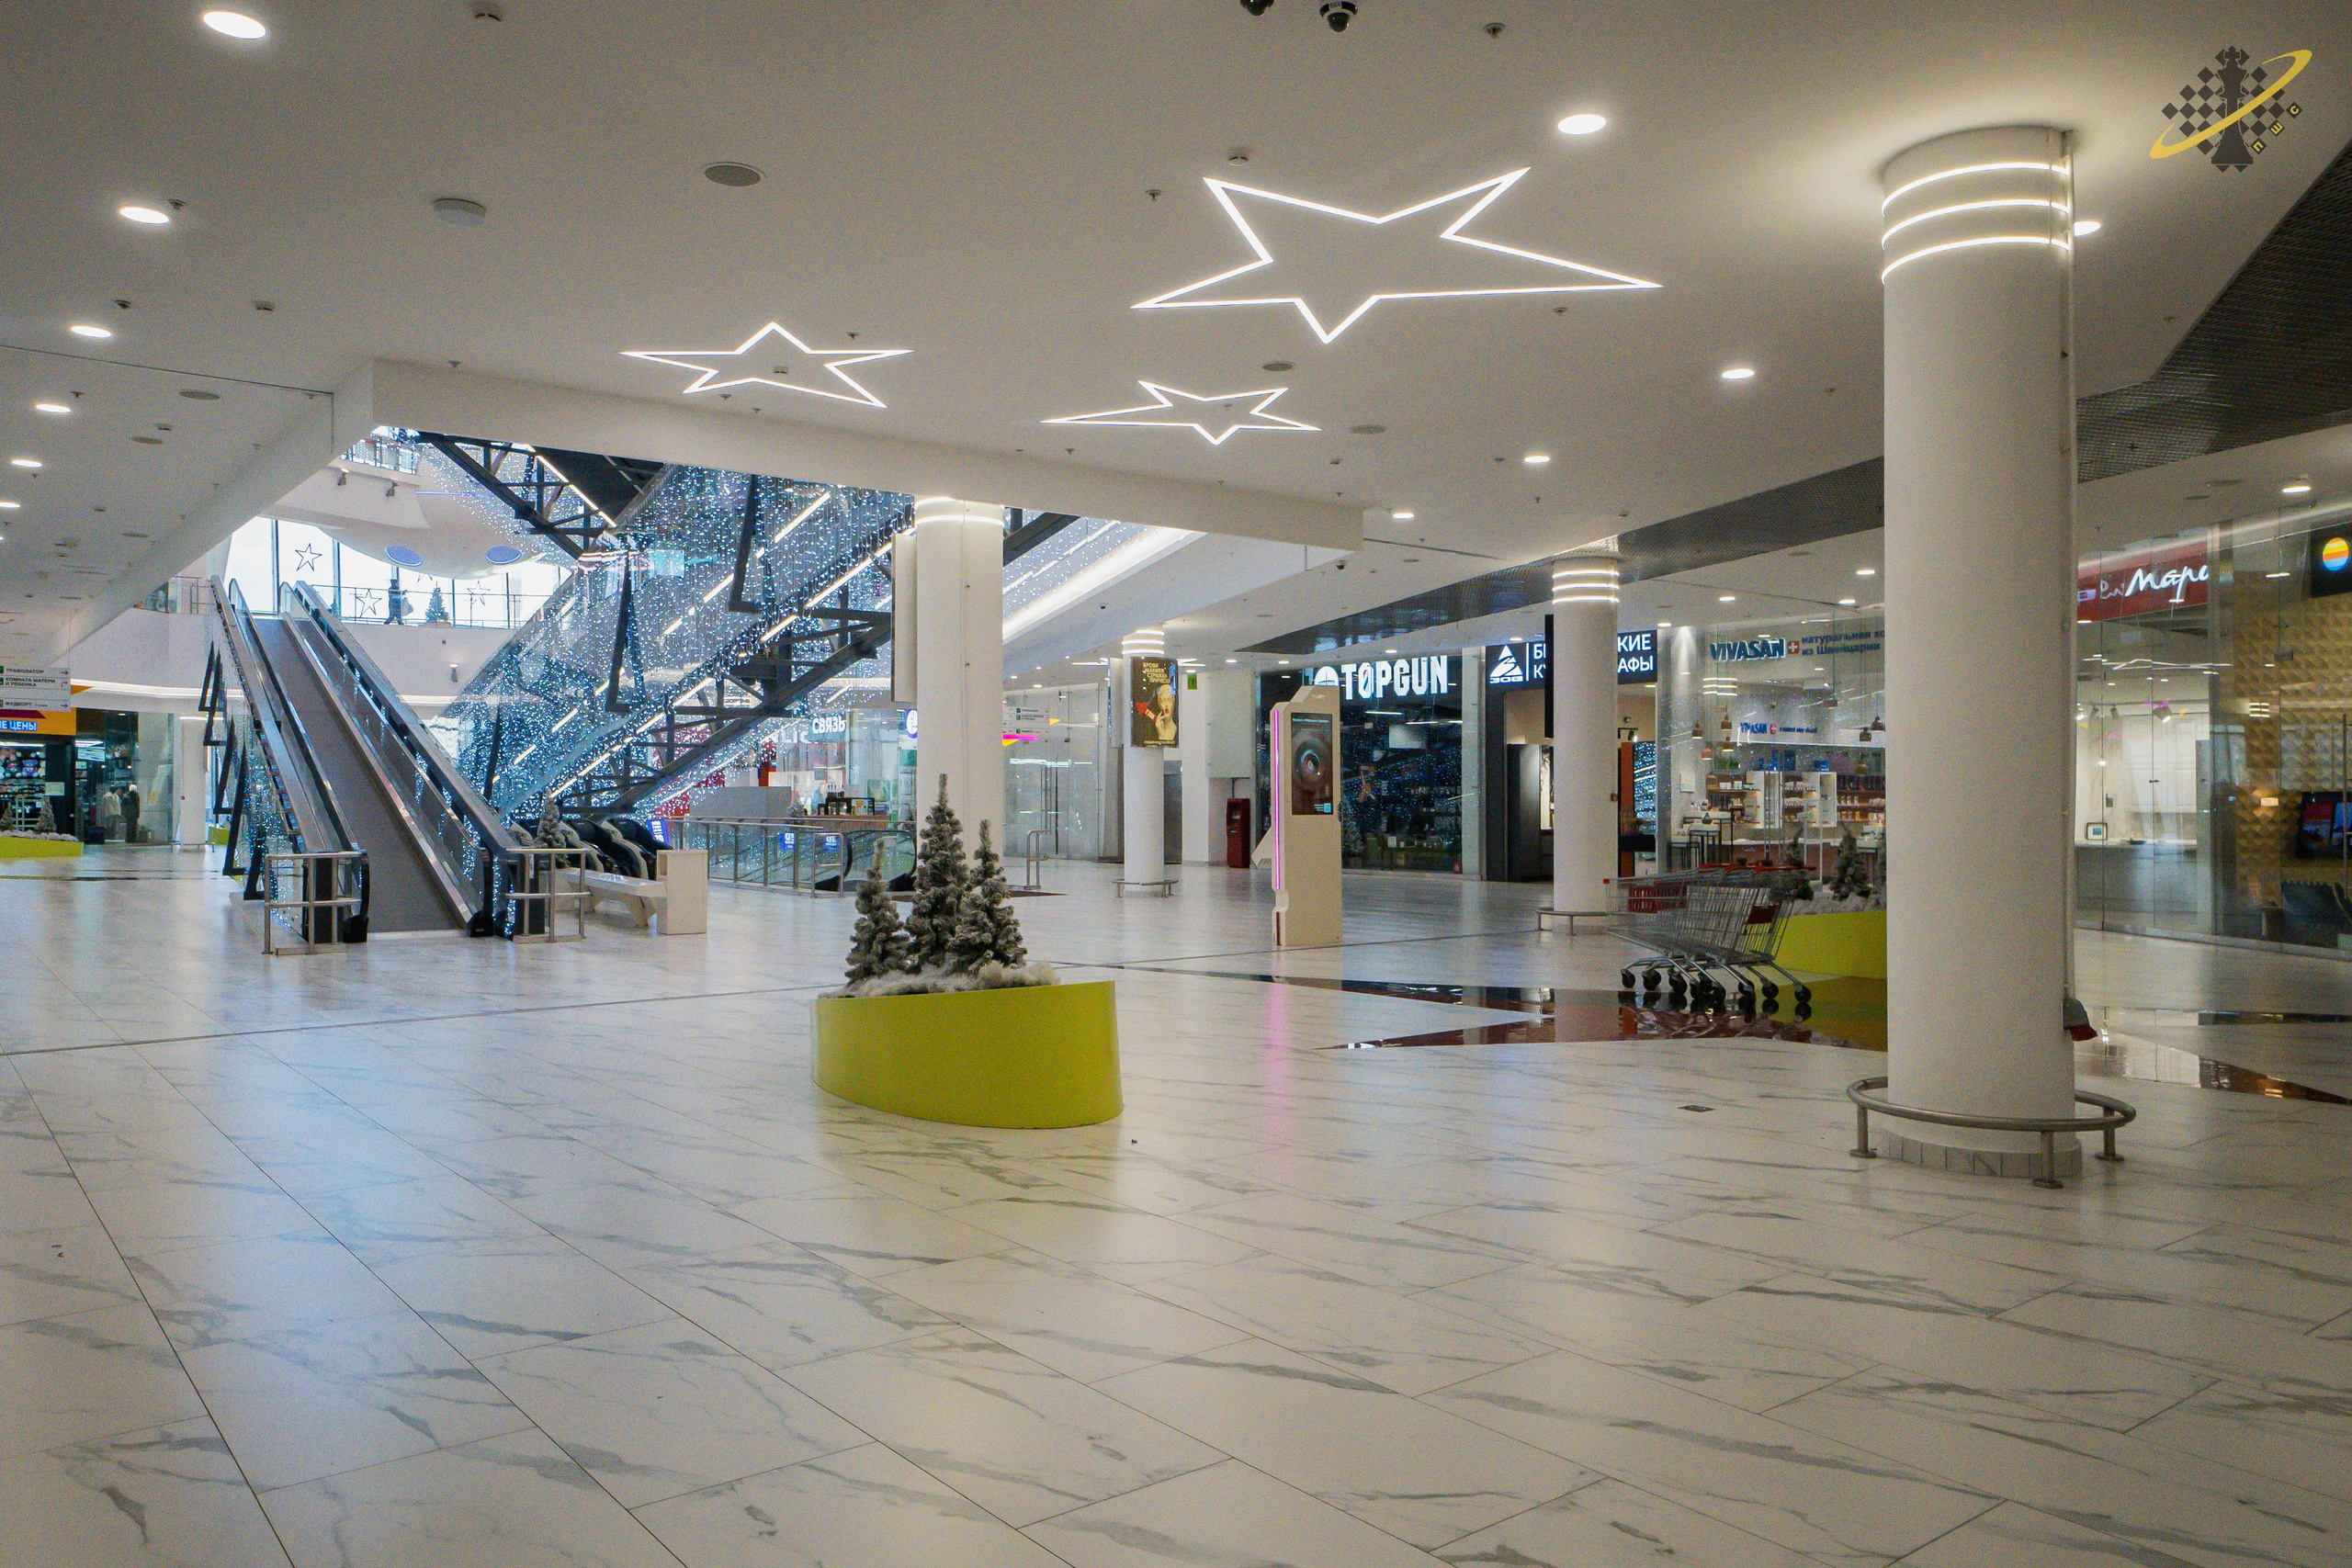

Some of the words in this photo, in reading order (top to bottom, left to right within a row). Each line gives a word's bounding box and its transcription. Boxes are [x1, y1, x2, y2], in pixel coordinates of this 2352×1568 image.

[1802, 631, 1871, 645] натуральная
[1710, 637, 1786, 662] VIVASAN
[1802, 648, 1815, 657] из
[1816, 642, 1881, 655] Швейцарии
[8, 720, 38, 731] ЦЕНЫ
[812, 716, 846, 734] СВЯЗЬ
